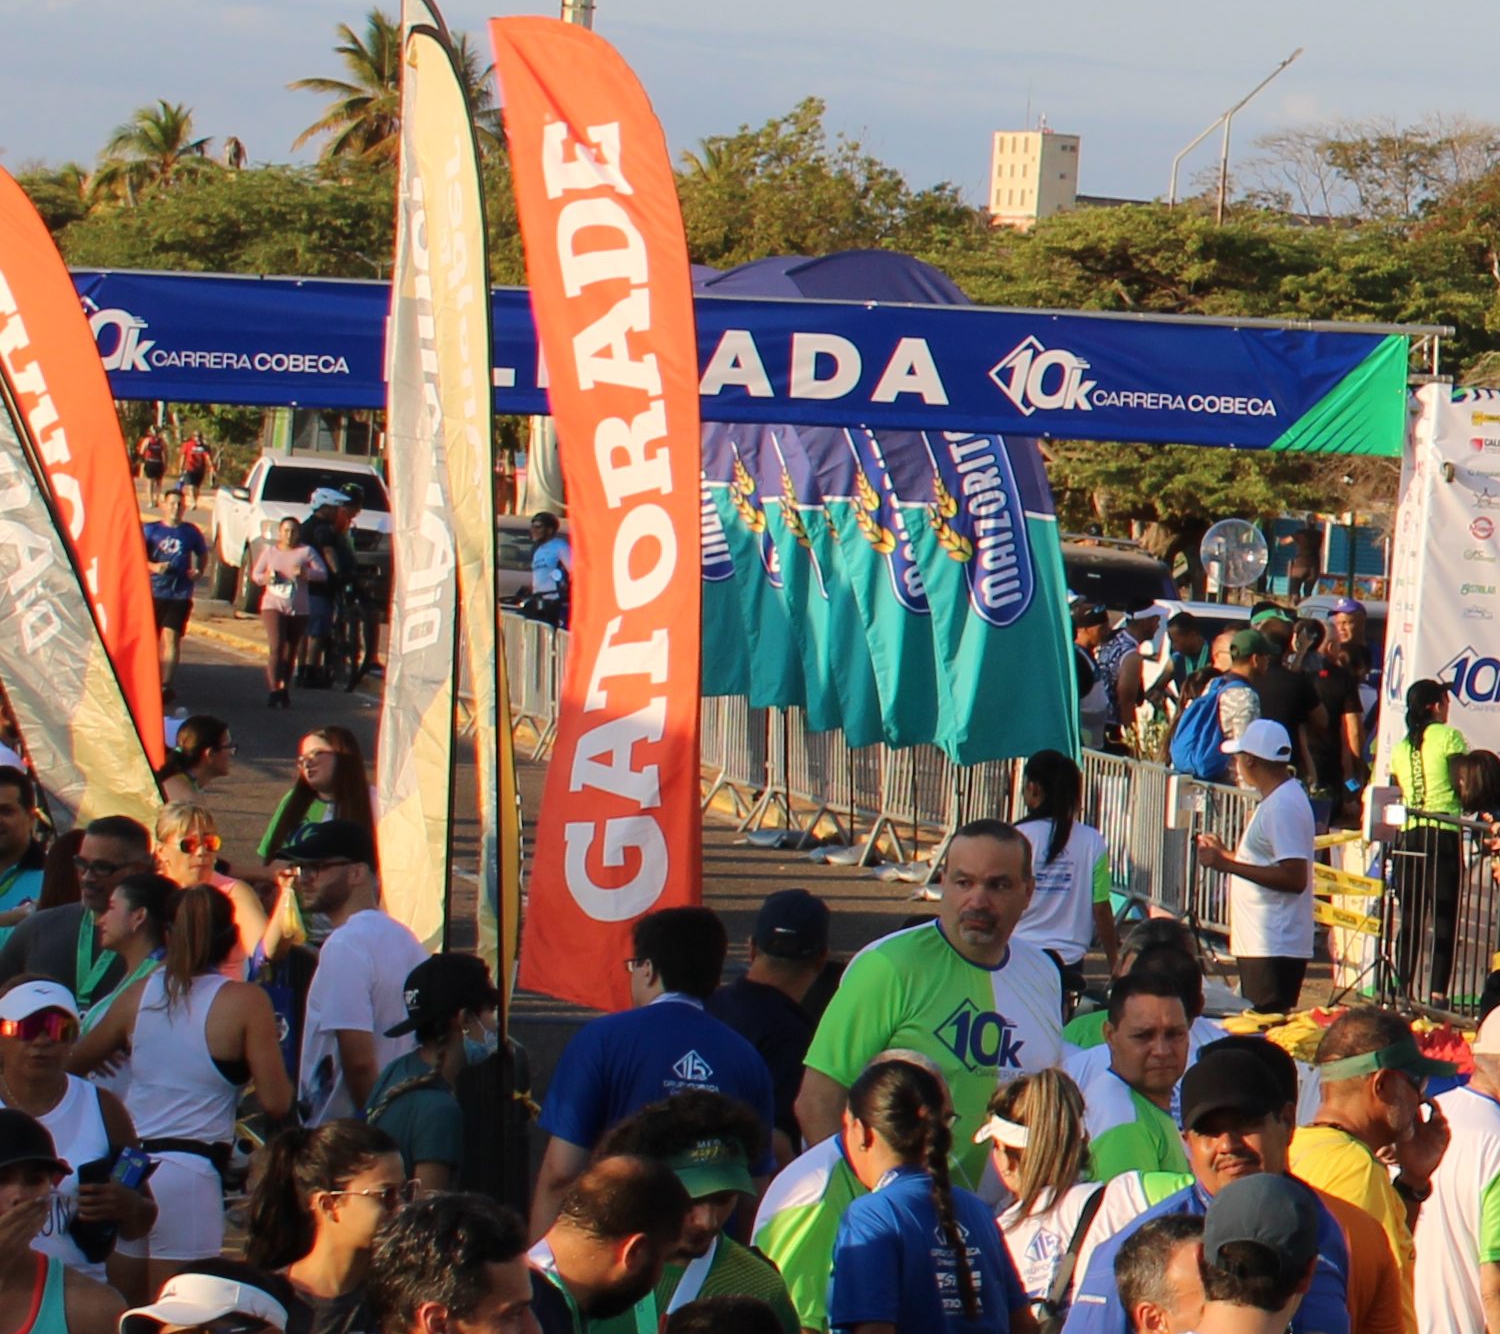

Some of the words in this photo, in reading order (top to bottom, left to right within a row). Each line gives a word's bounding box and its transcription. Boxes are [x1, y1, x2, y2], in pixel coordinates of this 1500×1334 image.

[152, 350, 253, 369] CARRERA
[254, 353, 350, 374] COBECA
[1092, 390, 1186, 410] CARRERA
[1187, 395, 1277, 416] COBECA
[543, 120, 680, 923] GATORADE
[942, 431, 1023, 610] MAIZORIT
[946, 1010, 1026, 1069] 10k
